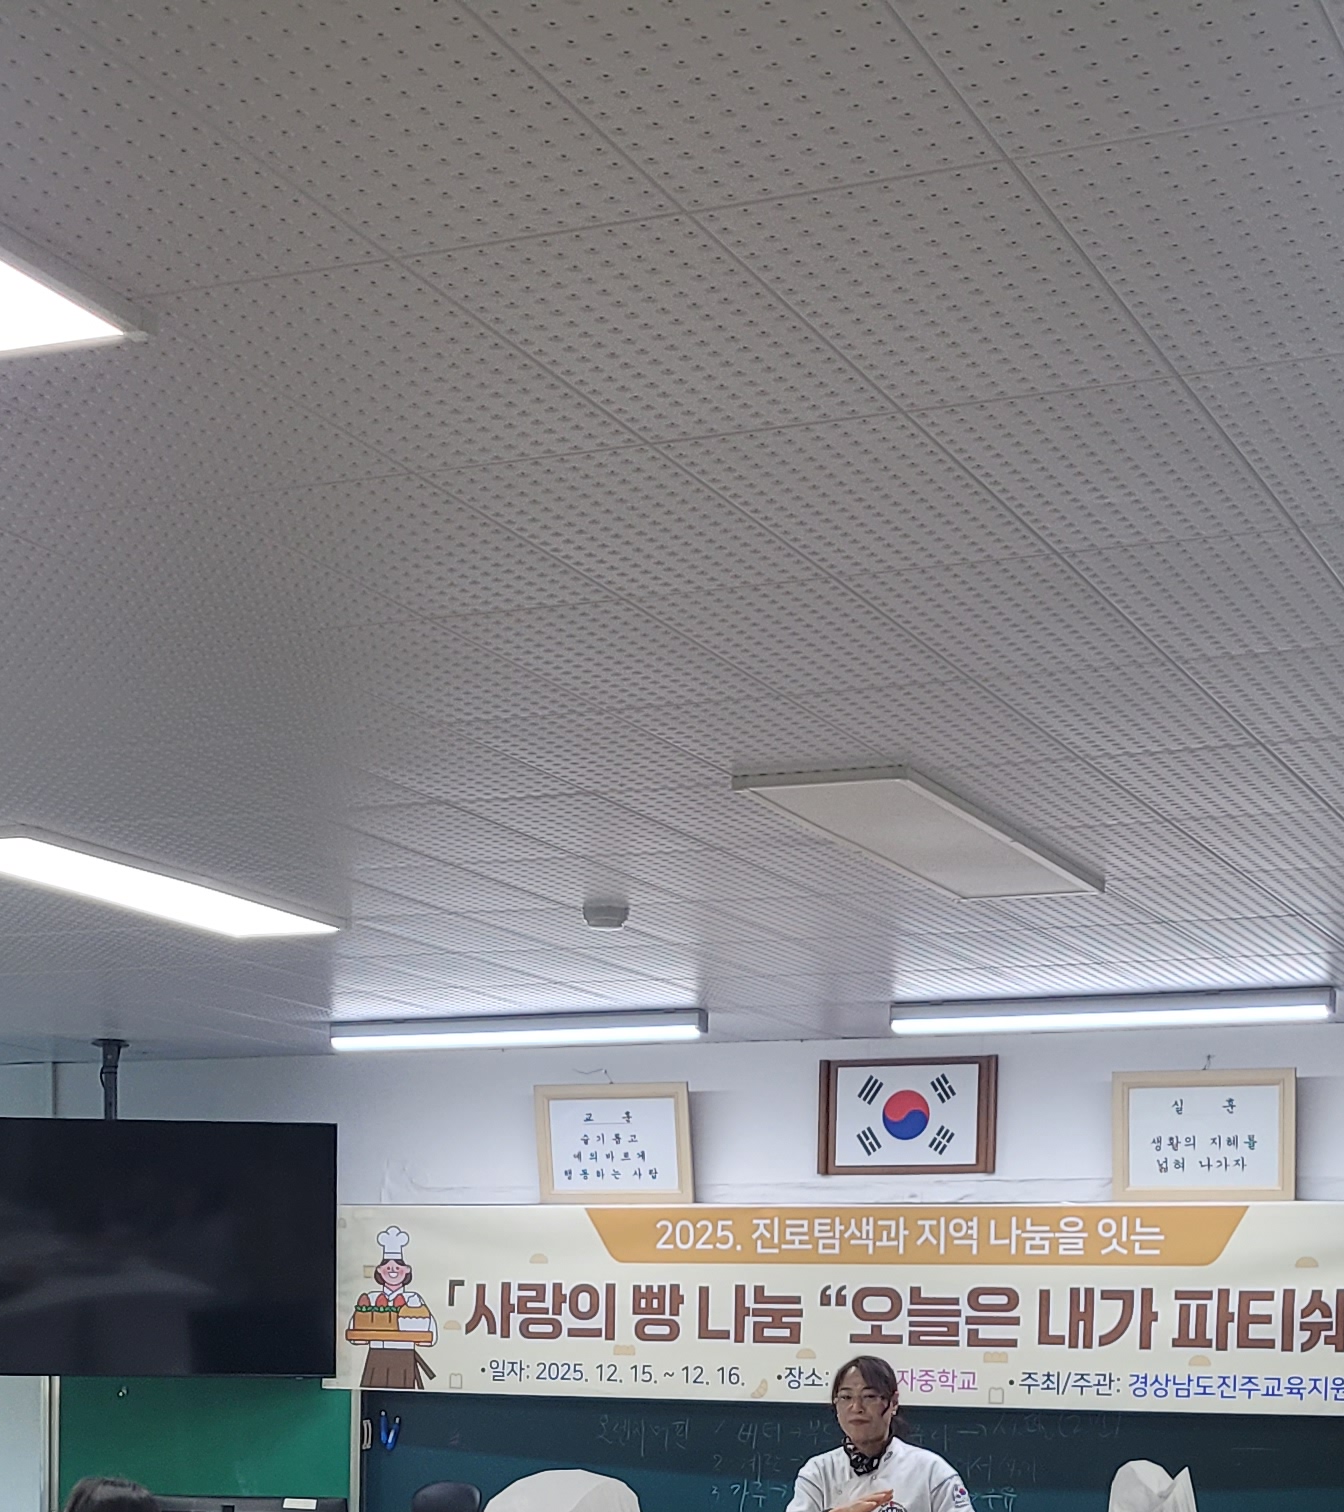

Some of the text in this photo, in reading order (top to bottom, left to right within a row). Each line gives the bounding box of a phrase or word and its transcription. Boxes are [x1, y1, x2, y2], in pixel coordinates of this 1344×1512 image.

[1151, 1135, 1196, 1151] 생활의
[656, 1215, 1165, 1255] 2025. 진로탐색과 지역 나눔을 잇는
[631, 1284, 684, 1342] 빵
[698, 1284, 804, 1344] 나눔
[1037, 1287, 1158, 1350] 내가
[536, 1361, 589, 1382] 2025.
[596, 1363, 623, 1383] 12.
[628, 1363, 658, 1384] 15.
[682, 1364, 711, 1385] 12.
[717, 1365, 745, 1386] 16.
[897, 1368, 978, 1392] 자중학교
